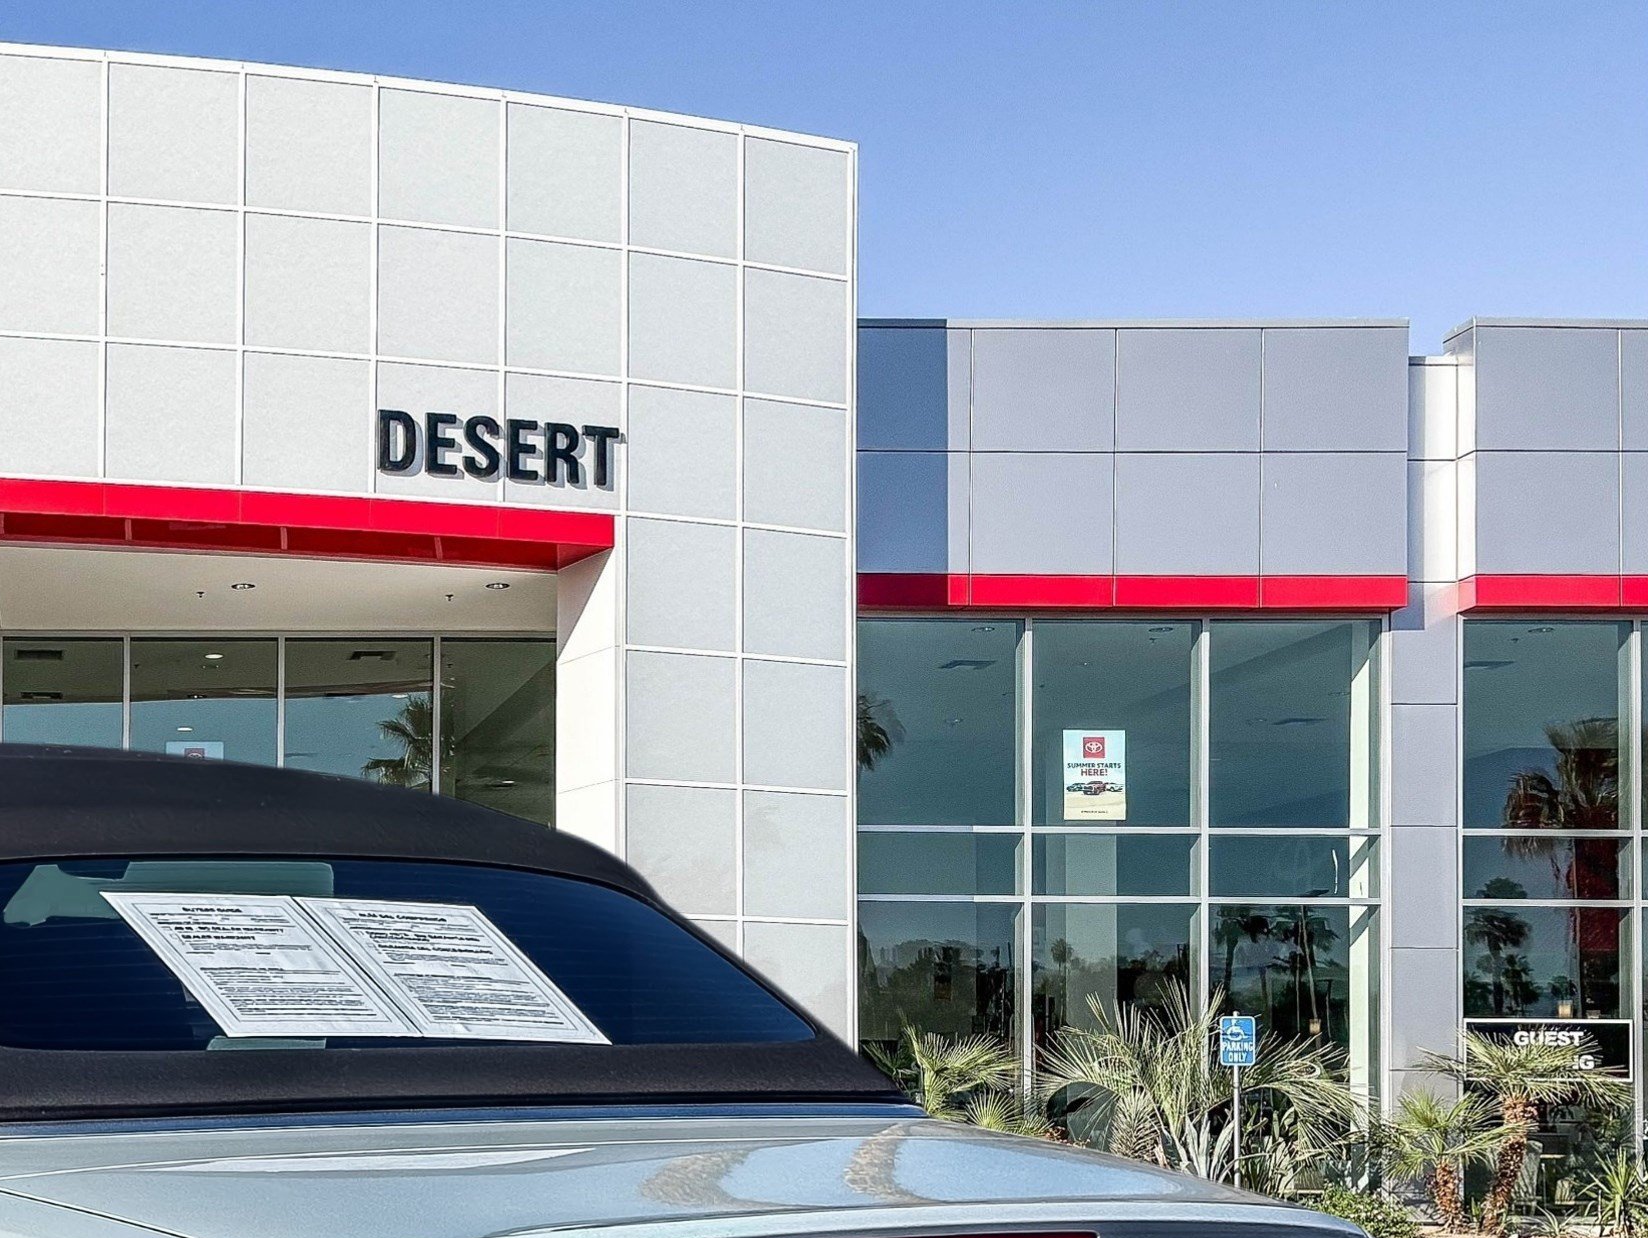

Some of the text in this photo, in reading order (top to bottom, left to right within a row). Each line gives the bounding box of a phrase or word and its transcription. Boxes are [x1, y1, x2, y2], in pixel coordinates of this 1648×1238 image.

[377, 409, 620, 487] DESERT
[1081, 768, 1108, 777] HERE!
[1513, 1031, 1584, 1047] GUEST
[1222, 1041, 1253, 1052] PARKING
[1228, 1051, 1247, 1063] ONLY
